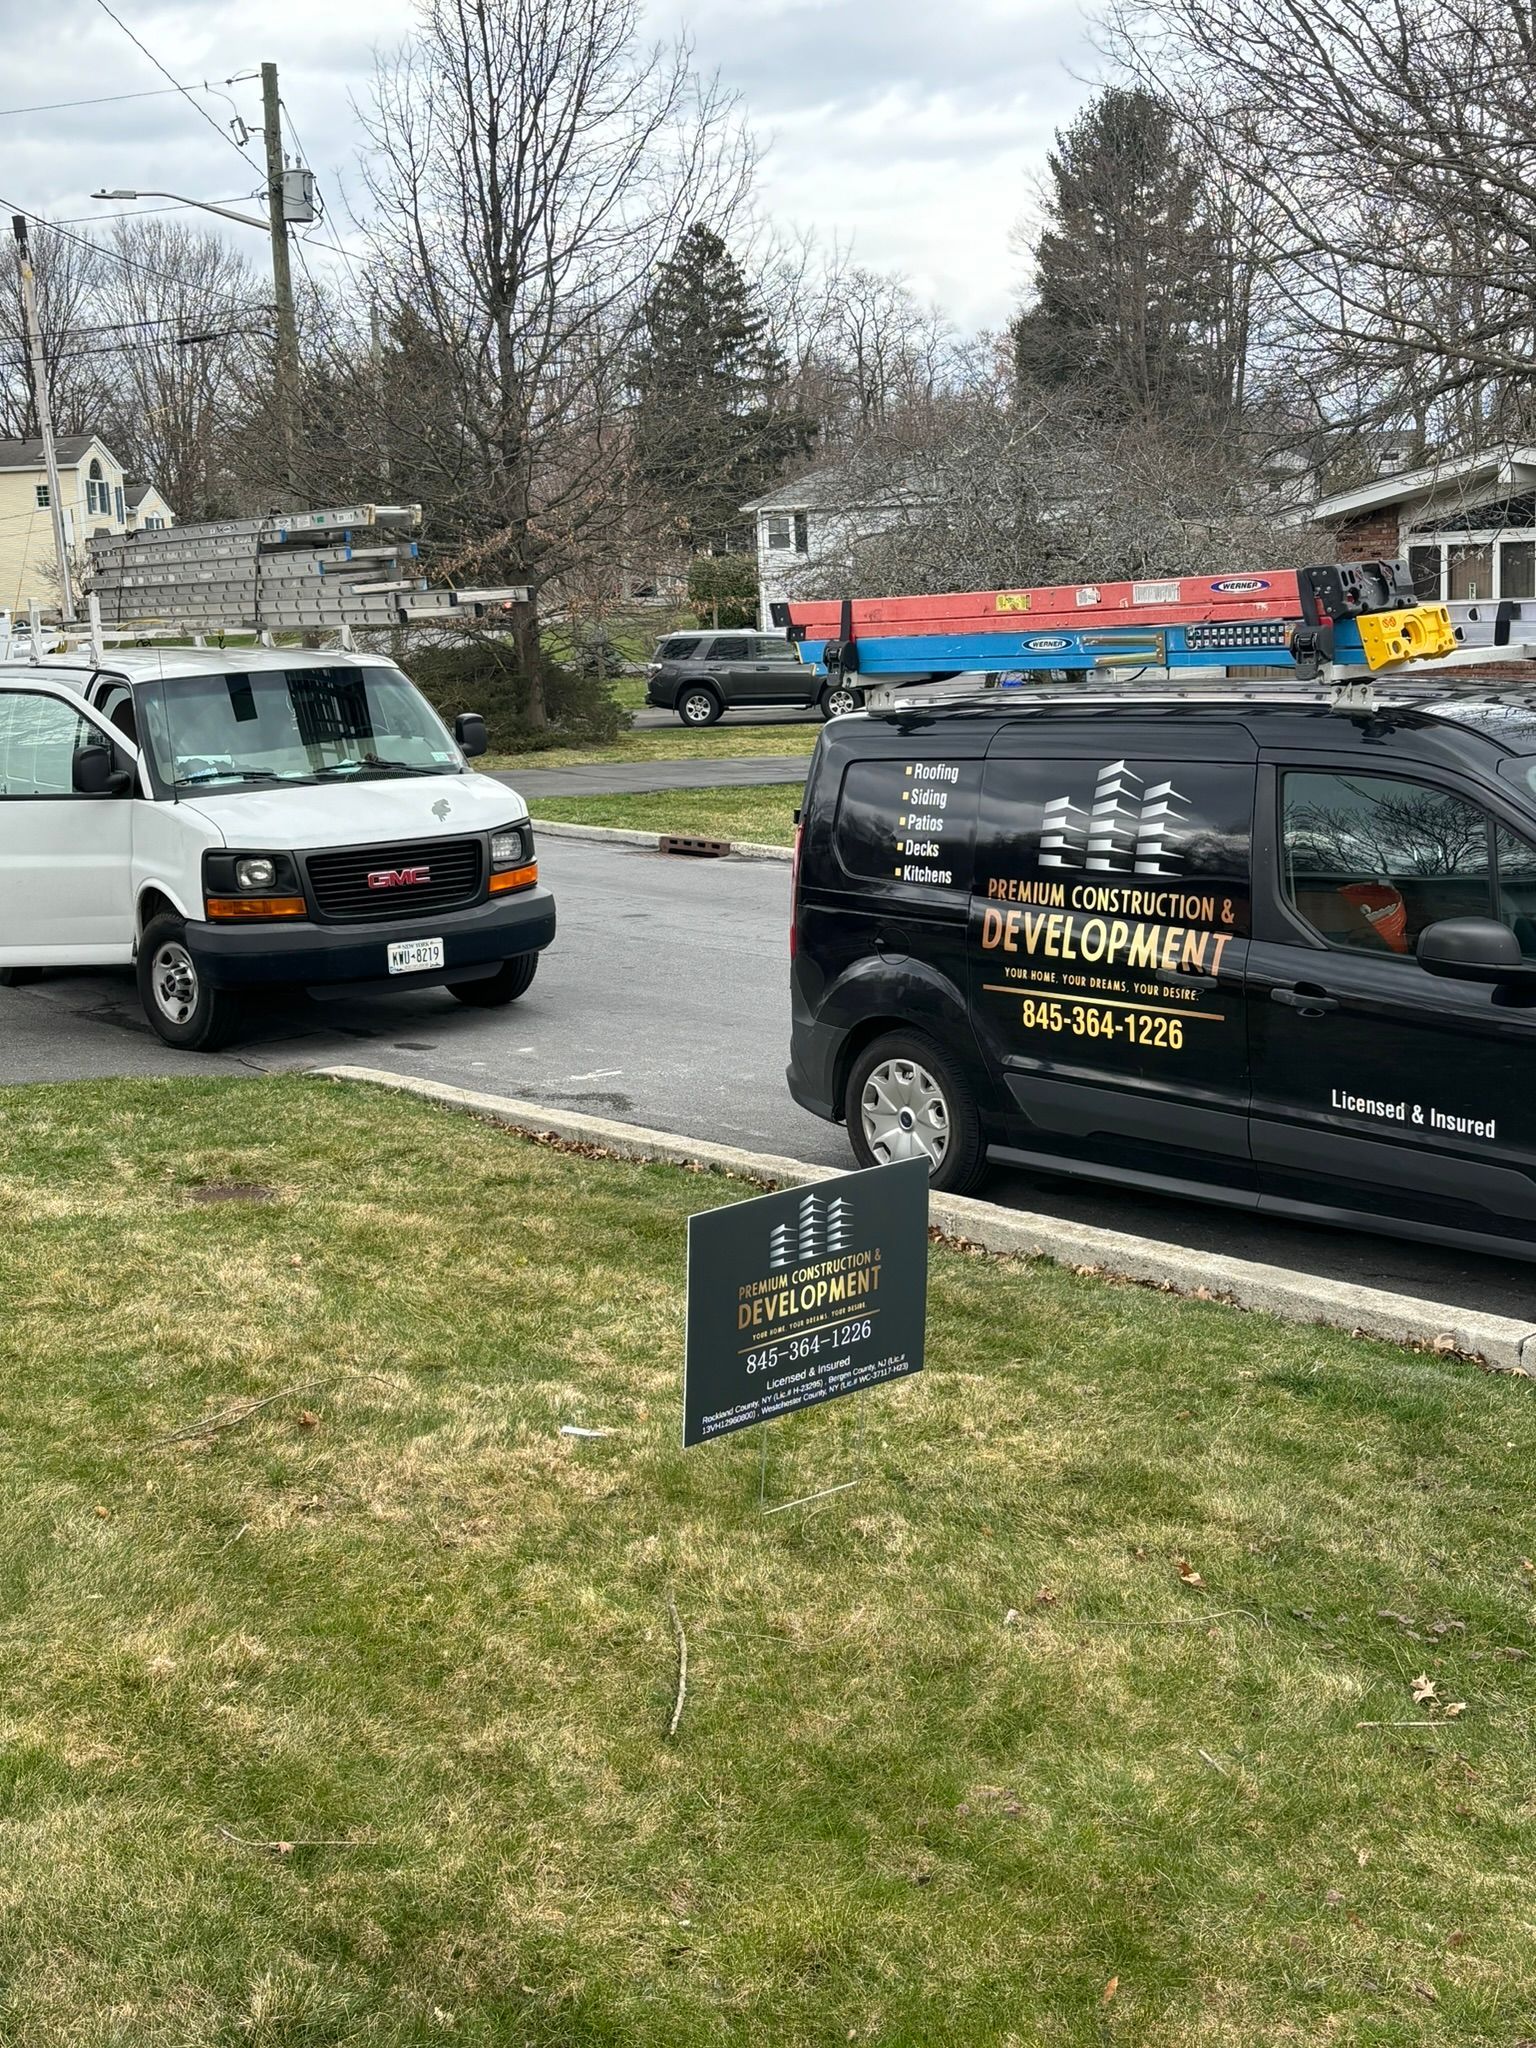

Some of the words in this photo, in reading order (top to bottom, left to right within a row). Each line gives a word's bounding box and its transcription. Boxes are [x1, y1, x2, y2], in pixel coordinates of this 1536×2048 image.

[1222, 581, 1259, 590] WERNER
[1032, 640, 1063, 648] WERNER
[914, 763, 960, 784] Roofing
[911, 787, 948, 809] Siding
[907, 813, 944, 832] Patios
[905, 839, 940, 857] Decks
[367, 866, 432, 889] GMC
[903, 864, 953, 885] Kitchens
[987, 877, 1065, 907] PREMIUM
[1071, 885, 1215, 922] CONSTRUCTION
[1220, 898, 1235, 924] &
[981, 906, 1234, 977] DEVELOPMENT
[1004, 966, 1028, 980] YOUR
[1062, 973, 1087, 987] YOUR
[1133, 982, 1160, 996] YOUR
[1162, 986, 1200, 1001] DESIRE.
[1022, 999, 1183, 1050] 845-364-1226
[1331, 1088, 1406, 1121] Licensed
[1411, 1104, 1424, 1125] &
[1430, 1107, 1496, 1139] Insured
[738, 1273, 789, 1300] PREMIUM
[791, 1250, 872, 1285] CONSTRUCTION
[874, 1248, 882, 1261] &
[737, 1264, 882, 1331] DEVELOPMENT
[752, 1330, 768, 1341] YOUR
[789, 1319, 804, 1330] YOUR
[831, 1307, 846, 1318] YOUR
[746, 1319, 872, 1374] 845-364-1226
[766, 1368, 807, 1391] Licensed
[808, 1366, 816, 1377] &
[817, 1355, 851, 1374] Insured
[702, 1407, 735, 1424] Rockland
[735, 1400, 760, 1414] County,
[761, 1394, 773, 1404] NY
[828, 1370, 852, 1385] Bergen
[877, 1358, 887, 1369] NJ
[761, 1396, 802, 1415] Westchester
[828, 1383, 840, 1393] NY
